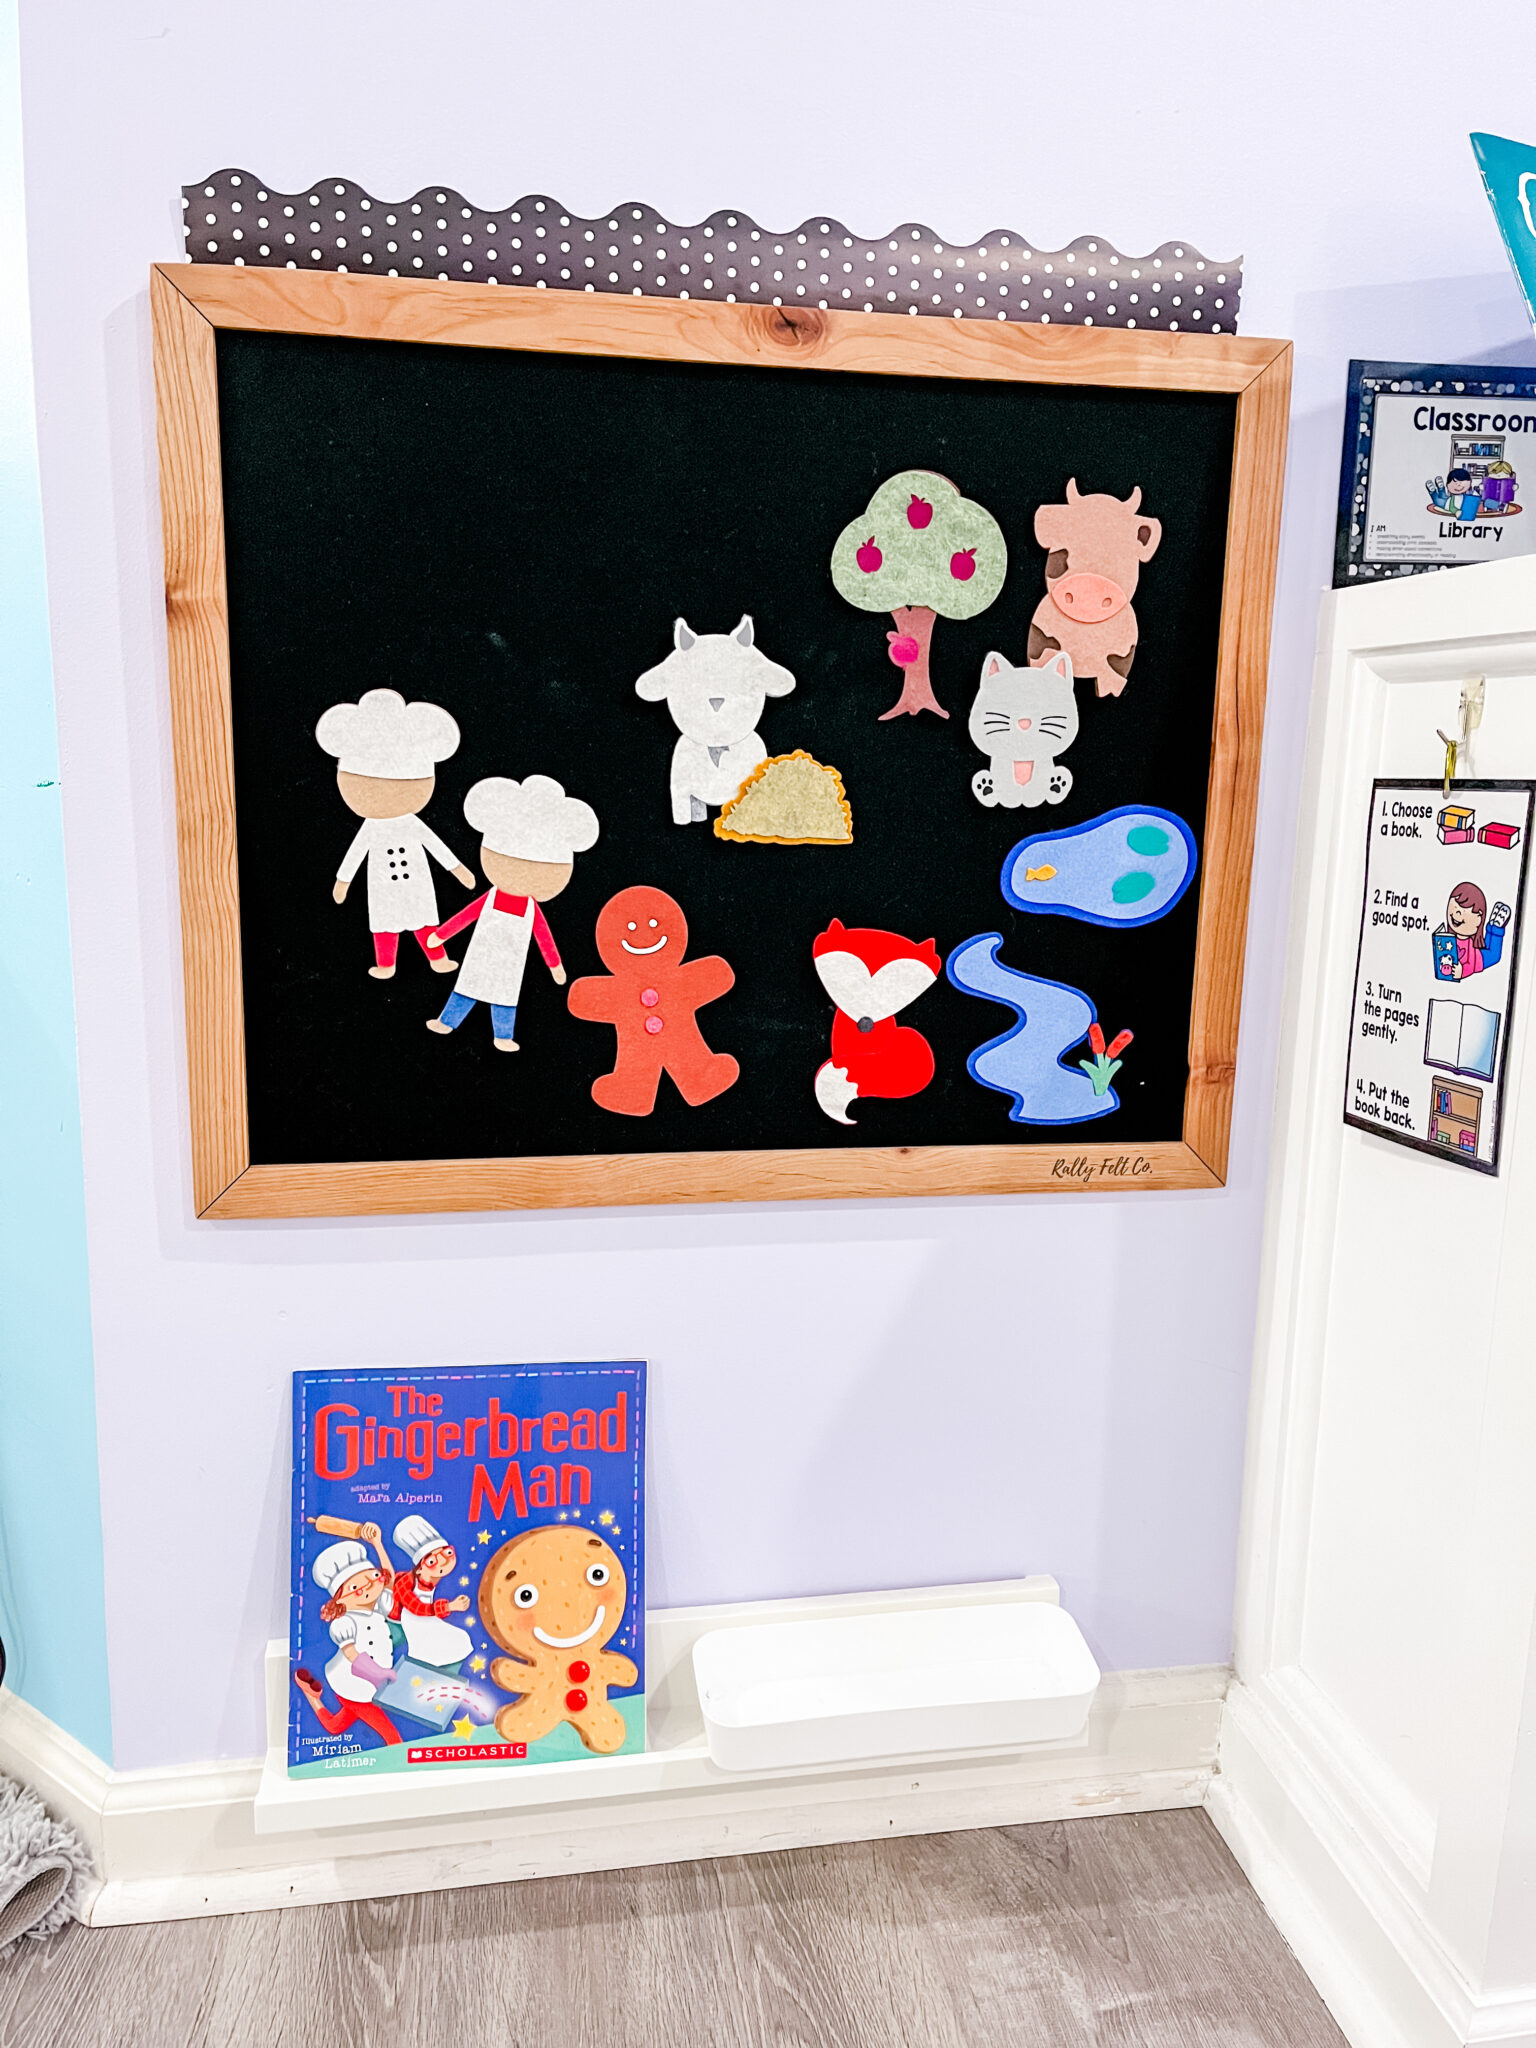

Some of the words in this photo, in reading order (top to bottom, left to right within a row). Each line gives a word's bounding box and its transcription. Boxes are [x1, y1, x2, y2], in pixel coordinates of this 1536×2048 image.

[1376, 524, 1386, 532] AM
[1439, 521, 1503, 542] Library
[1382, 801, 1388, 816] 1.
[1391, 801, 1433, 819] Choose
[1380, 824, 1388, 836] a
[1391, 821, 1422, 838] book.
[1373, 889, 1382, 904] 2.
[1385, 890, 1408, 908] Find
[1411, 896, 1419, 909] a
[1372, 911, 1399, 926] good
[1402, 915, 1430, 932] spot.
[1365, 981, 1374, 997] 3.
[1378, 983, 1402, 1003] Turn
[1364, 1000, 1381, 1017] the
[1384, 1007, 1419, 1027] pages
[1361, 1021, 1398, 1044] gently.
[1356, 1078, 1366, 1095] 4.
[1368, 1082, 1387, 1101] Put
[1390, 1088, 1410, 1108] the
[1355, 1096, 1380, 1119] book
[1383, 1106, 1415, 1131] back.
[1051, 1156, 1096, 1183] Rally
[1099, 1156, 1130, 1176] Felt
[1132, 1156, 1153, 1176] Co.
[386, 1385, 443, 1418] The
[314, 1391, 627, 1481] Gingerbread
[350, 1483, 380, 1493] adapted
[381, 1482, 391, 1491] by
[468, 1461, 591, 1523] Man
[357, 1493, 391, 1503] Mara
[395, 1492, 443, 1505] Alperin
[301, 1734, 342, 1746] Illustrated
[343, 1733, 353, 1742] by
[312, 1743, 362, 1757] Miriam
[324, 1756, 377, 1769] Latimer
[425, 1745, 525, 1759] SCHOLASTIC
